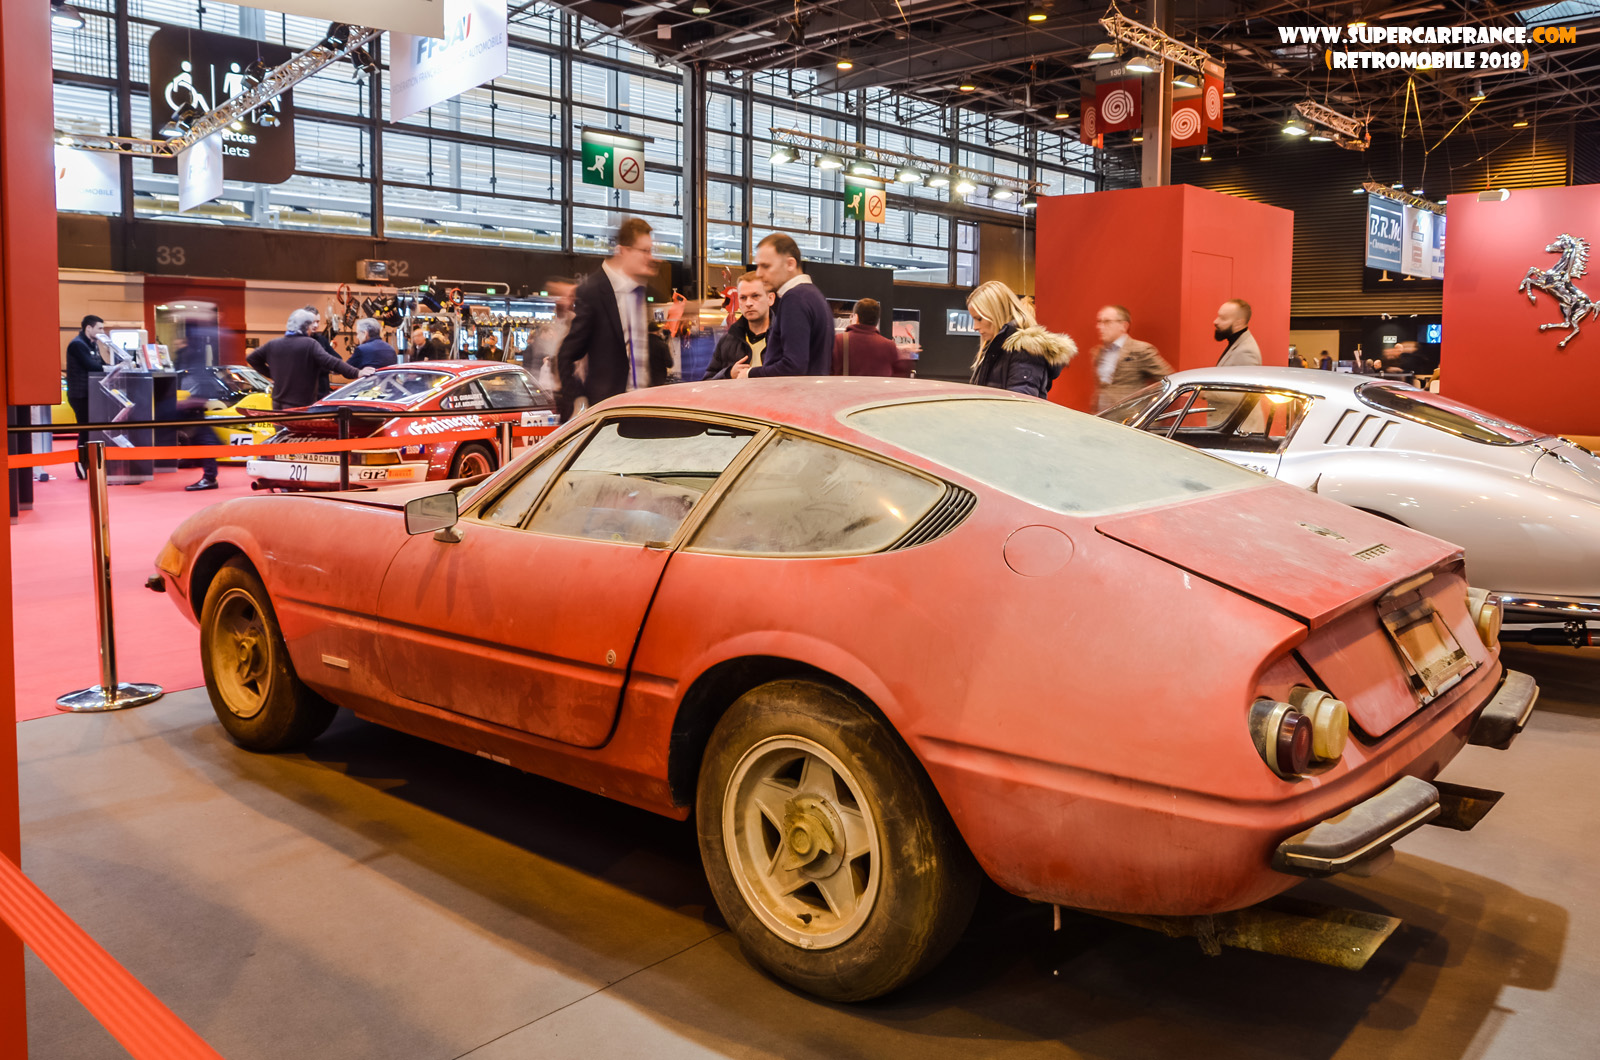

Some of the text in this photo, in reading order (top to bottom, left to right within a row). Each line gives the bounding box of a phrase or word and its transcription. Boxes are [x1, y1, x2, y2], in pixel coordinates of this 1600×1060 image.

[222, 131, 257, 144] ettes
[222, 144, 250, 158] lets
[157, 245, 186, 266] 33
[388, 260, 409, 278] 32
[303, 454, 340, 464] MARCHAL
[289, 464, 308, 481] 201
